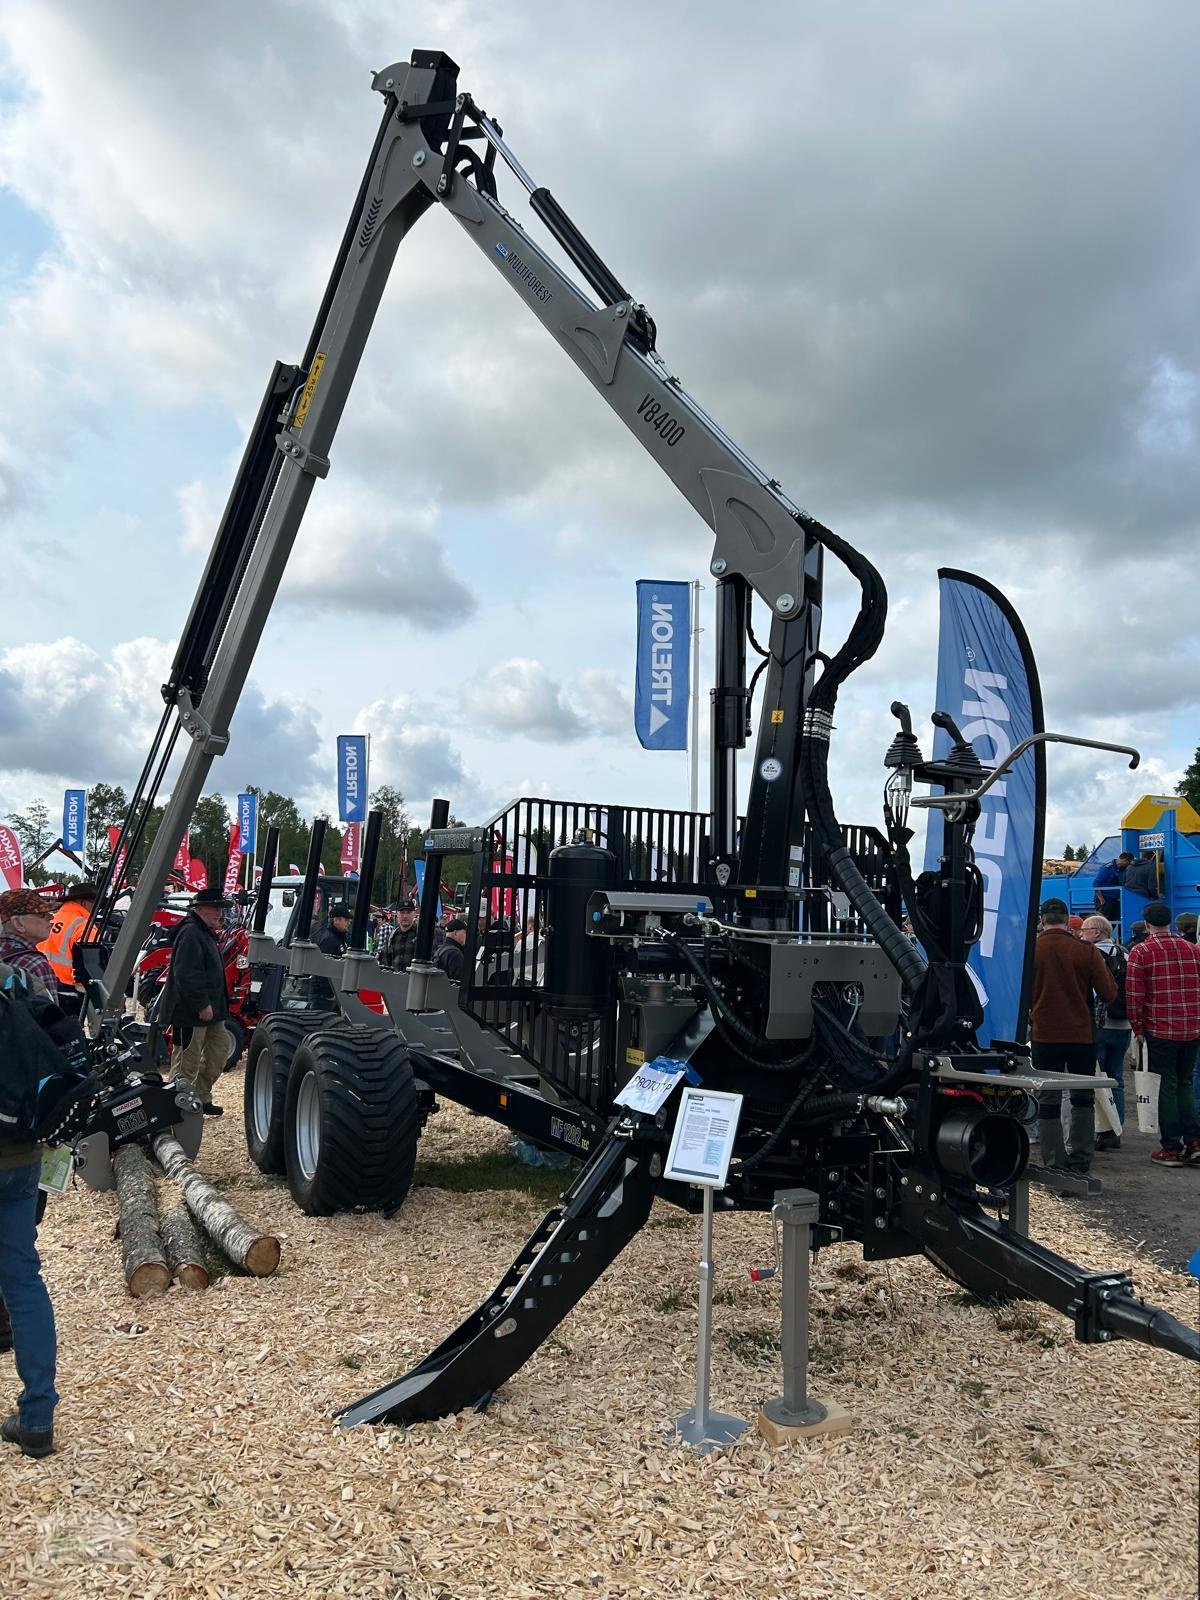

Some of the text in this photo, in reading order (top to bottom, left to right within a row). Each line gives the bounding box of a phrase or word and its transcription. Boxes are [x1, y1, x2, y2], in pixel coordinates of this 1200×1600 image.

[506, 250, 553, 304] MULTIFOREST
[636, 393, 686, 447] V8400
[633, 1075, 673, 1093] PROTOTYP
